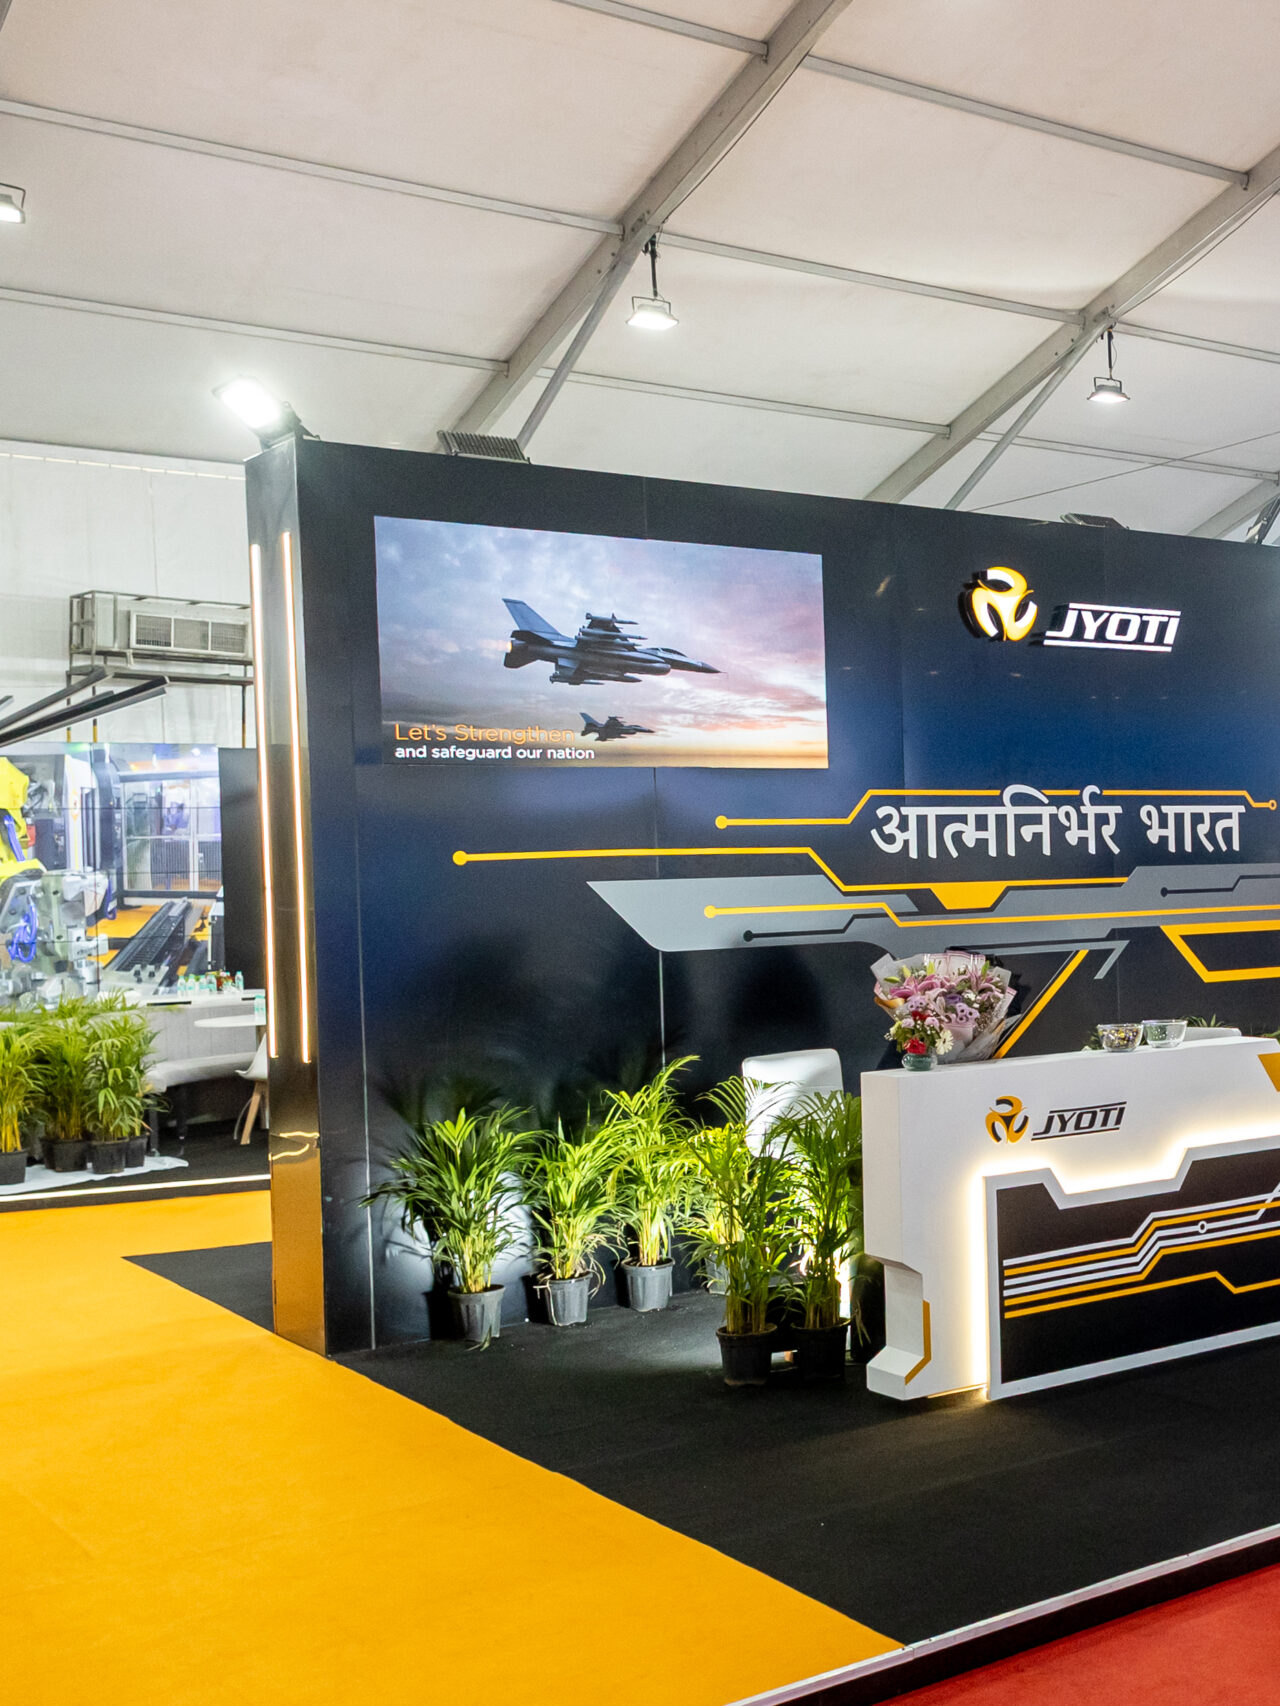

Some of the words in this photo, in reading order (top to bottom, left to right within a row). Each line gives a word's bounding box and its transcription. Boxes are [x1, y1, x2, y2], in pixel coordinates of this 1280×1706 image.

[1044, 608, 1181, 645] JYOTI
[394, 723, 448, 741] Let's
[454, 724, 576, 745] Strengthen
[394, 745, 428, 759] and
[431, 745, 513, 761] safeguard
[516, 749, 543, 760] our
[547, 747, 596, 760] nation
[870, 784, 1122, 860] आत्मनिर्भर
[1139, 804, 1247, 854] भारत
[1032, 1106, 1126, 1137] JYOTI
